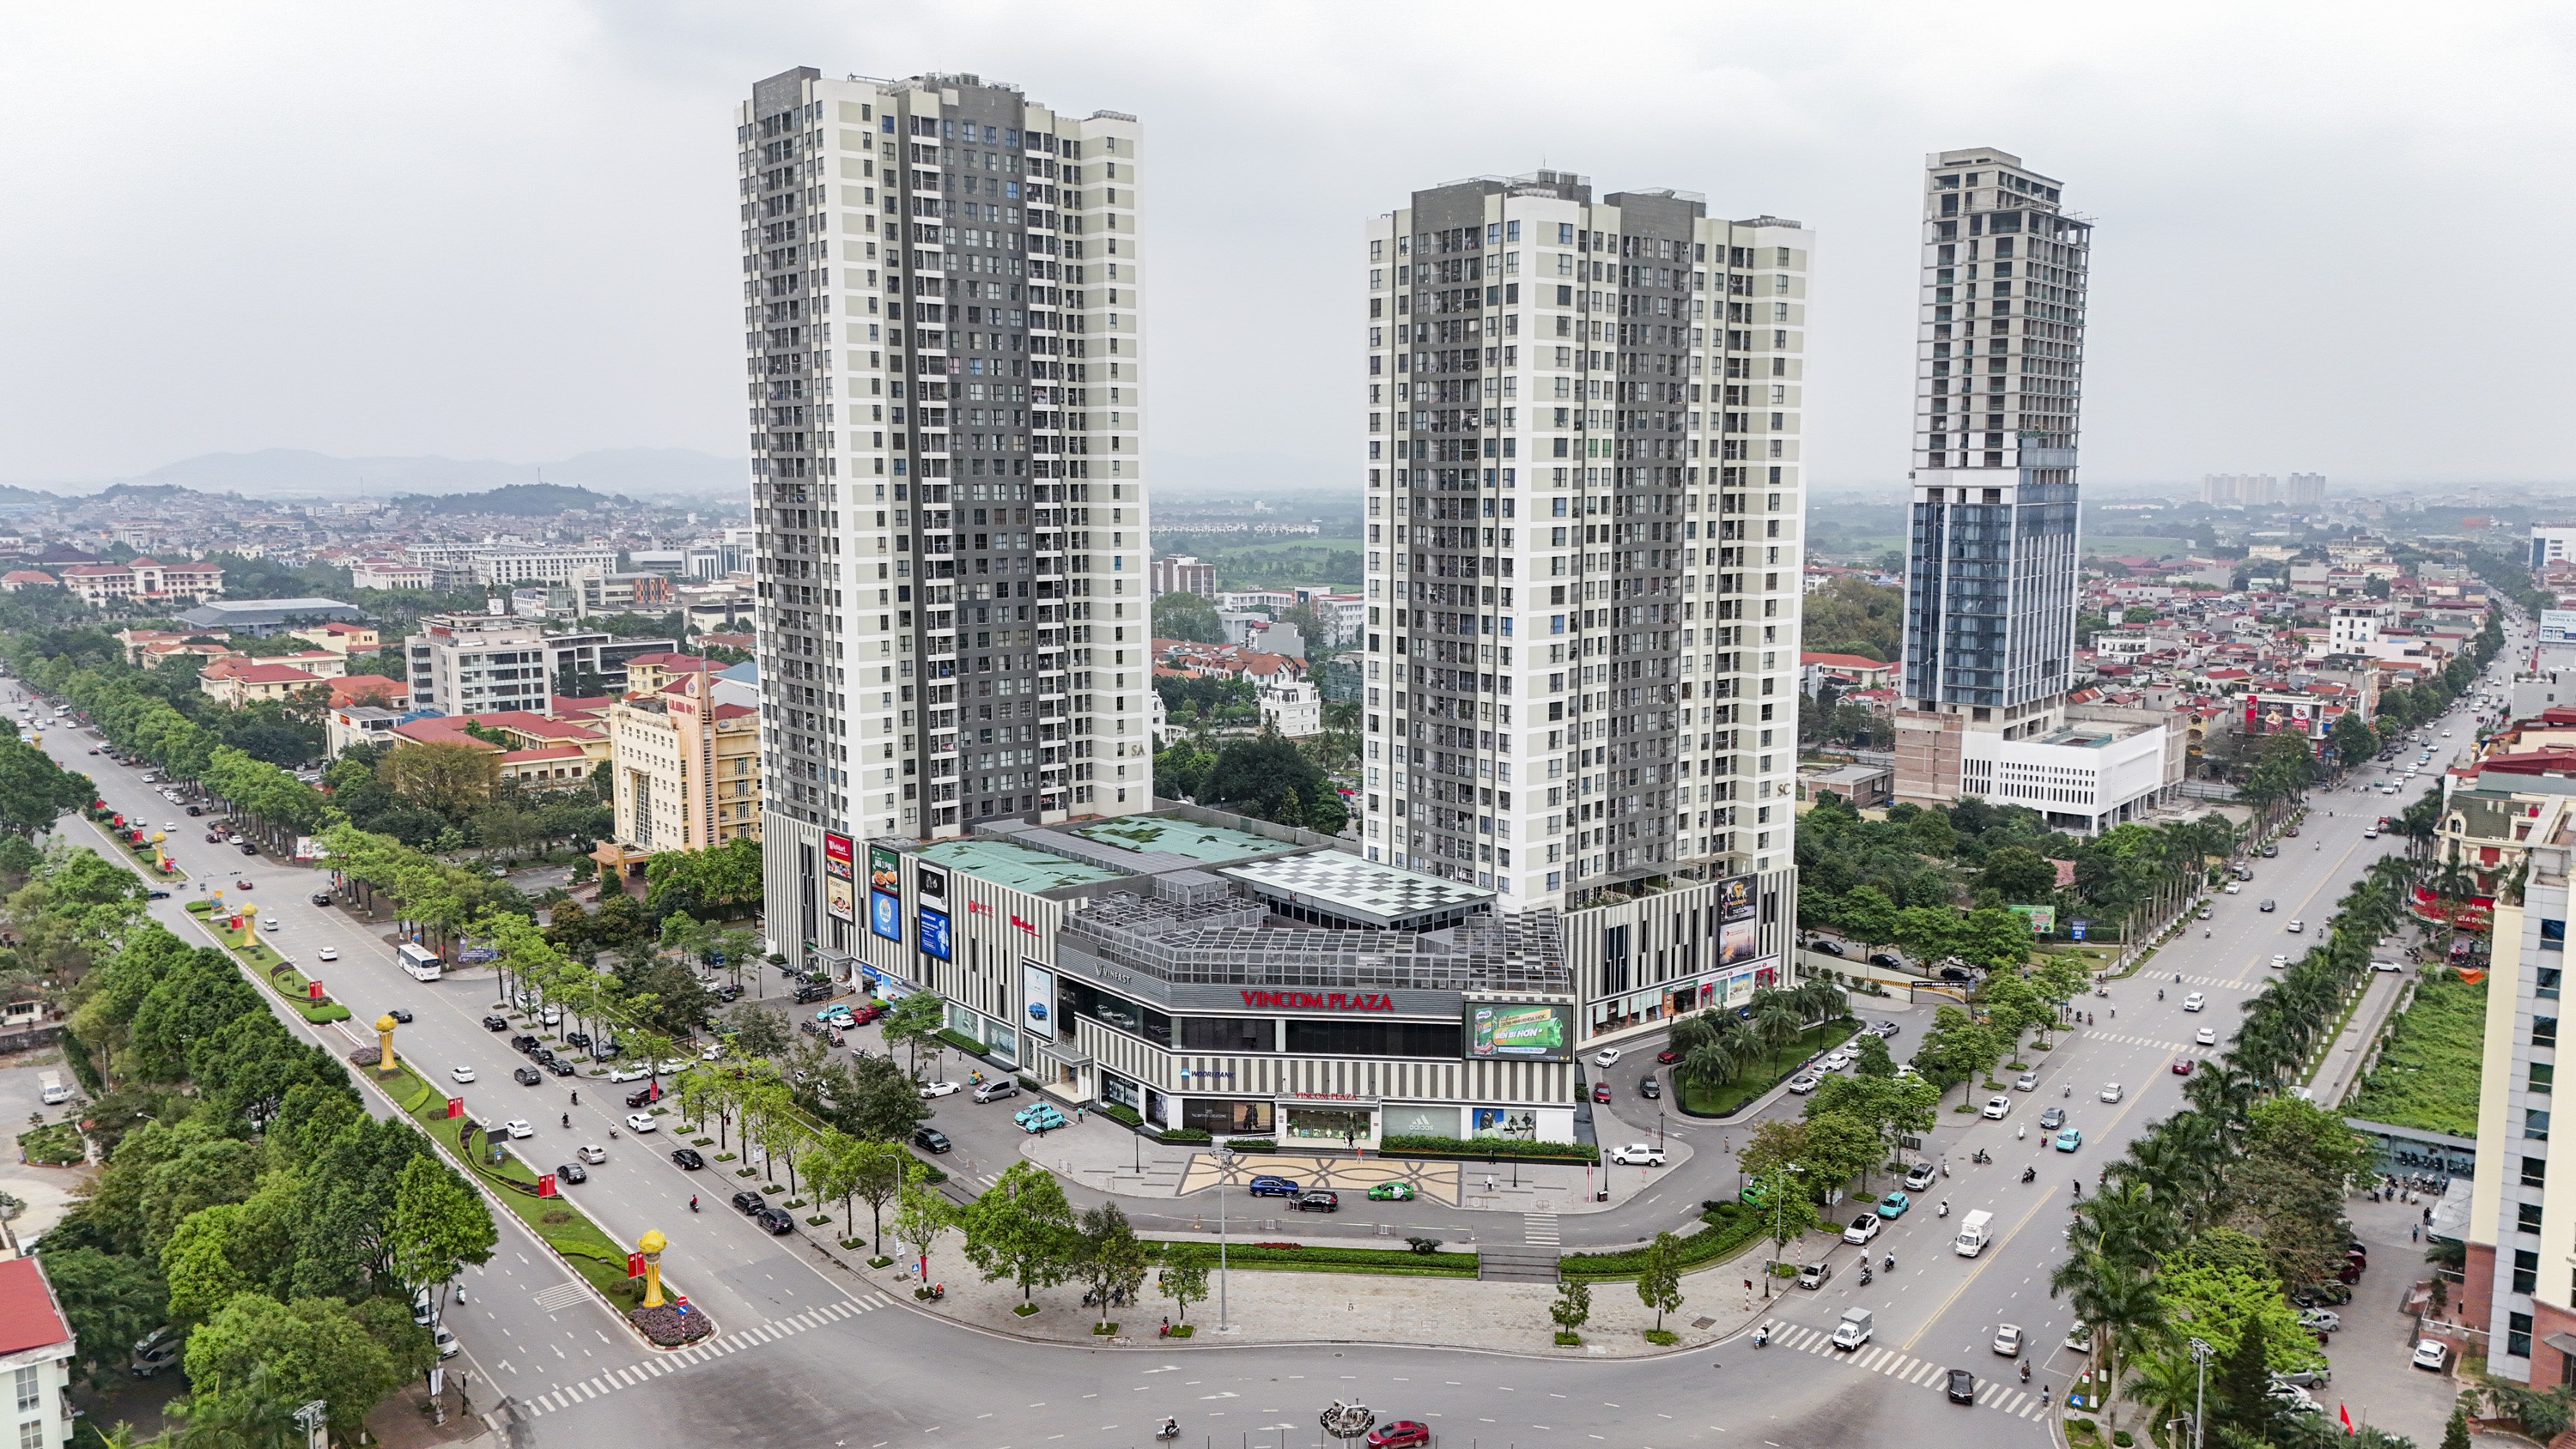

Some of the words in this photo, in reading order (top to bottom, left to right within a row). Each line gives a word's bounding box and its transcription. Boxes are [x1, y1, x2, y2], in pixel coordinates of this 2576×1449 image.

[1131, 743, 1146, 756] SA
[1777, 783, 1791, 797] SC
[1103, 967, 1131, 985] VINFAST
[1241, 990, 1324, 1009] VINCOM
[1327, 993, 1394, 1010] PLAZA
[1118, 1077, 1133, 1088] ALDO
[1295, 1091, 1328, 1100] VINCOM
[1408, 1123, 1434, 1131] adidas
